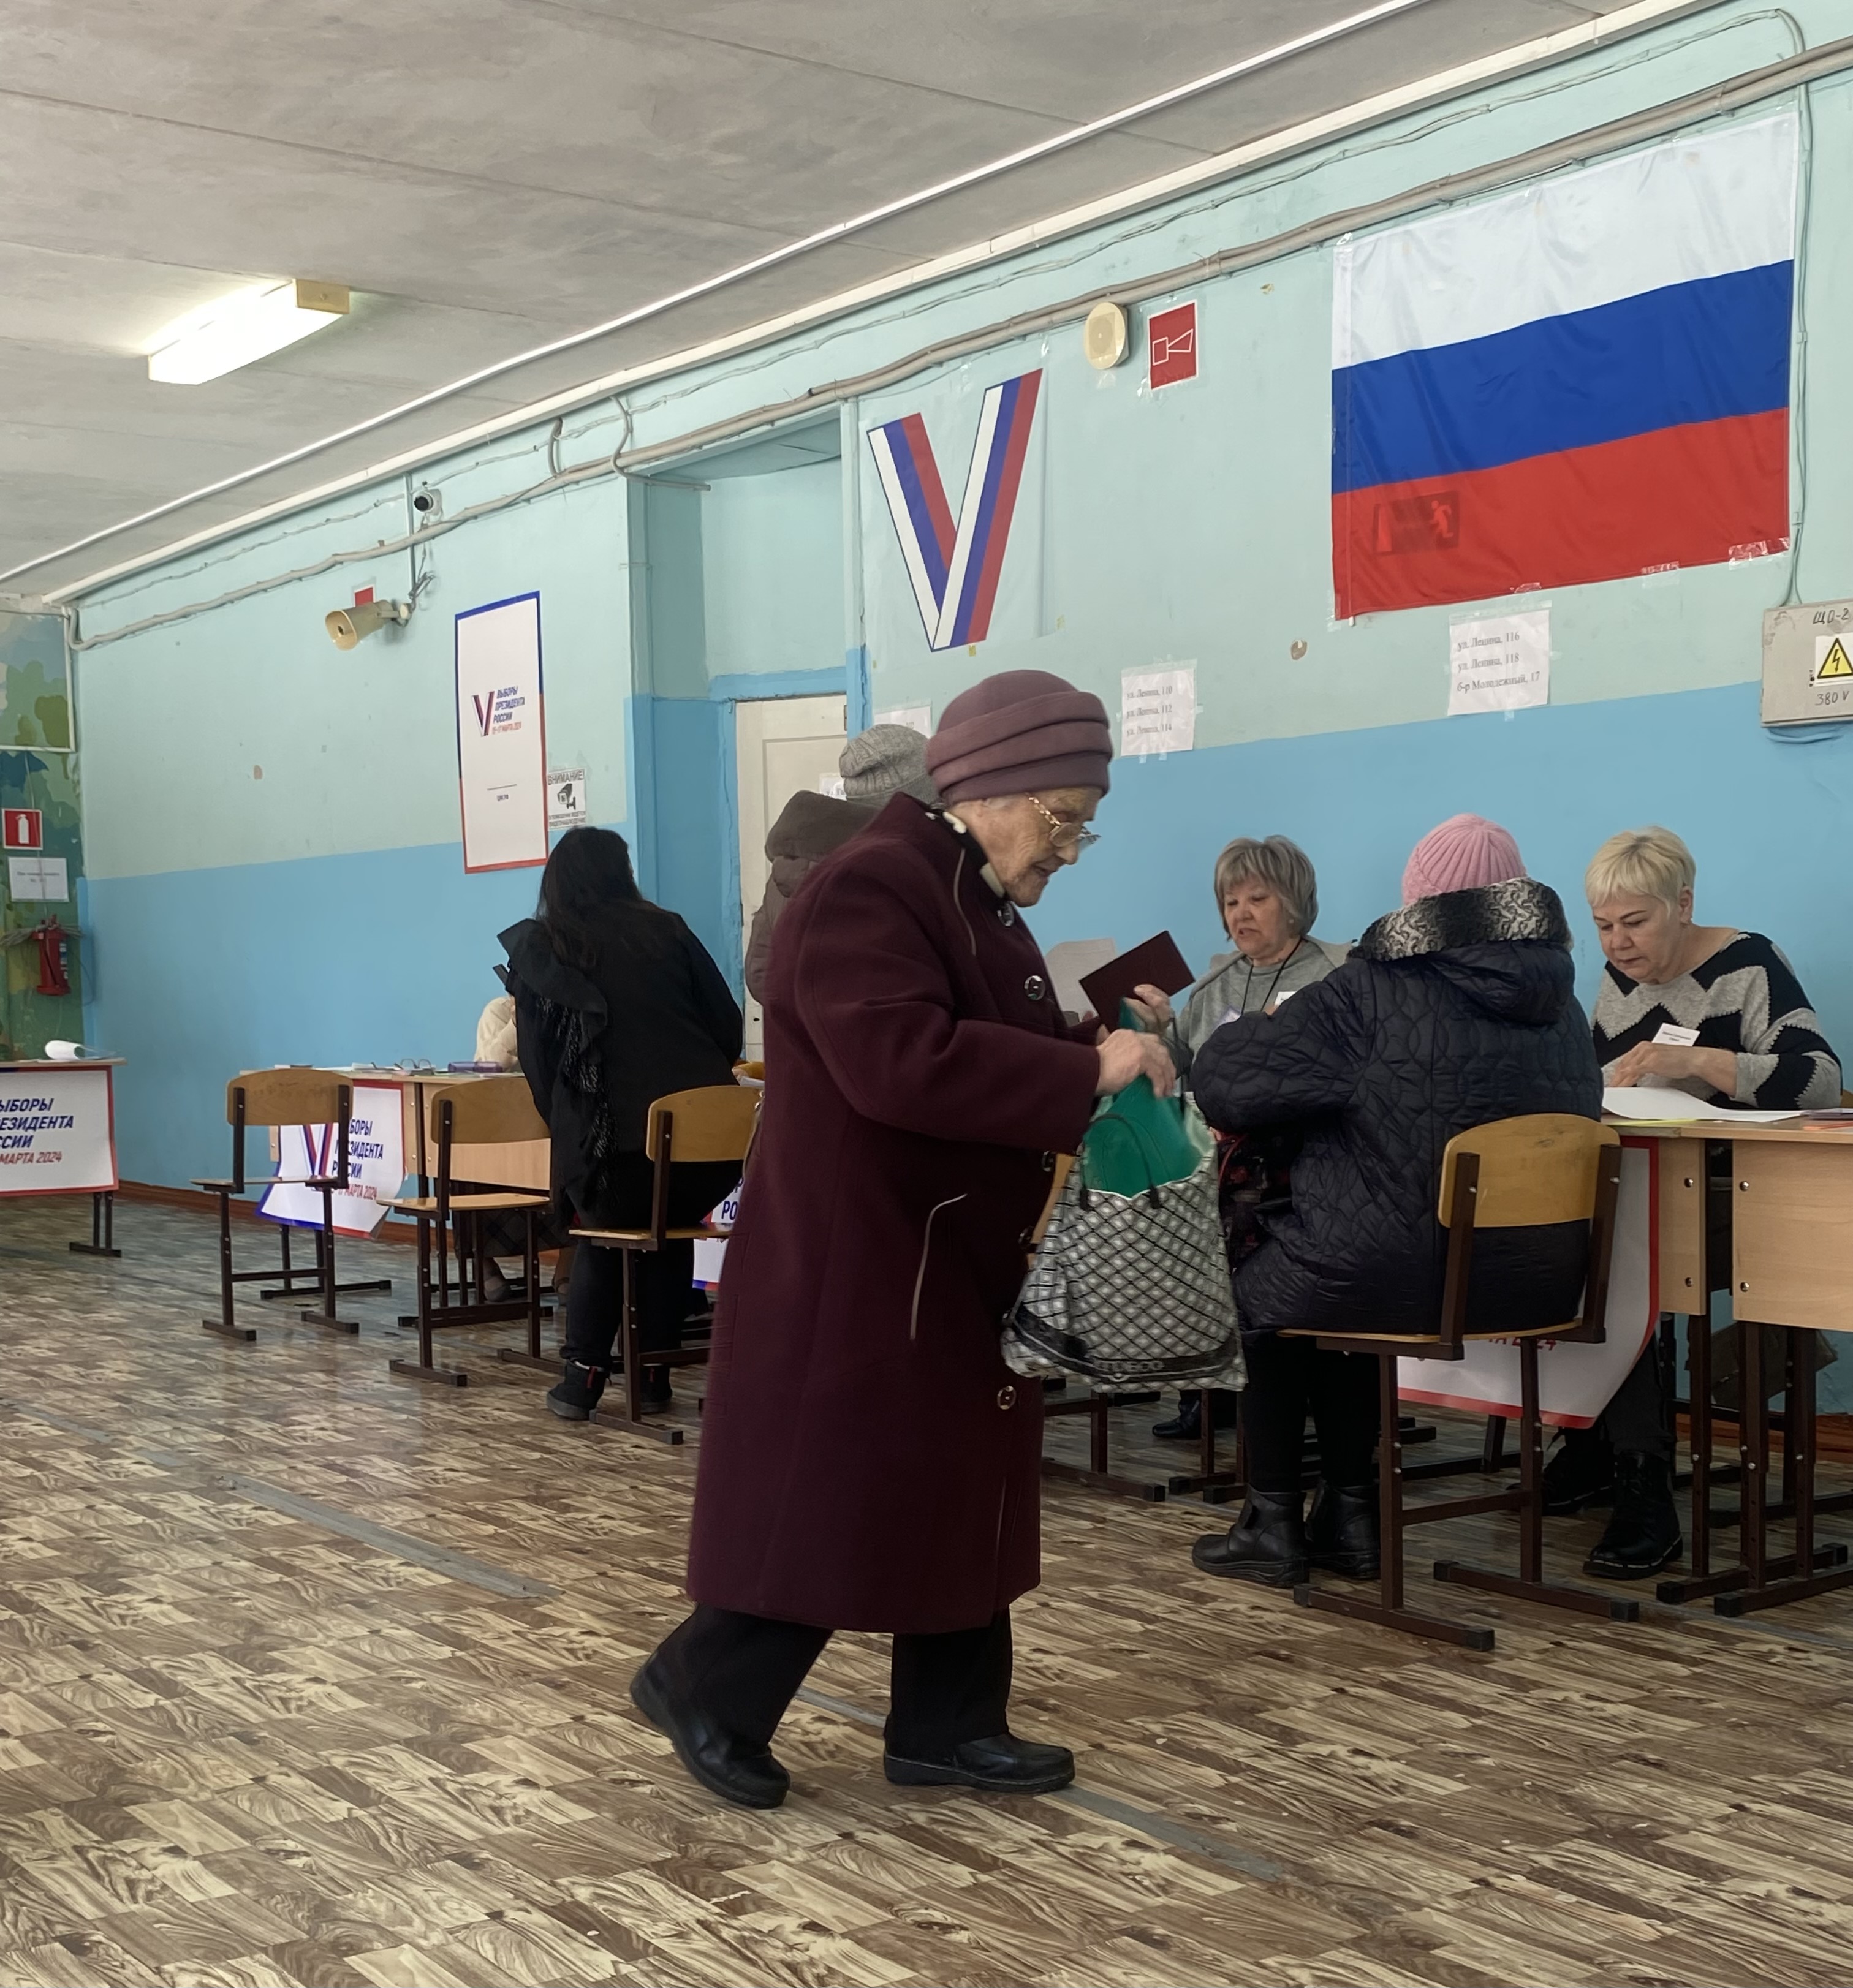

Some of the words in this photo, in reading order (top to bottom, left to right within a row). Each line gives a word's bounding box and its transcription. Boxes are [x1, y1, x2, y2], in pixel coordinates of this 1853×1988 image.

[1457, 641, 1469, 652] ул.
[1471, 637, 1503, 648] Ленина,
[1506, 632, 1520, 642] 116
[1457, 662, 1469, 673] ул.
[1471, 657, 1502, 669] Ленина,
[1506, 652, 1520, 664] 118
[1162, 686, 1172, 695] 110
[1457, 681, 1470, 694] б-р
[1531, 671, 1540, 682] 17
[1814, 691, 1838, 706] 380
[1843, 690, 1849, 701] V
[1162, 704, 1172, 714] 112
[0, 1098, 54, 1112] ЫБОРЫ
[0, 1116, 74, 1132] ЕЗИДЕНТА
[349, 1119, 373, 1136] БОРЫ
[36, 1151, 62, 1163] 2024
